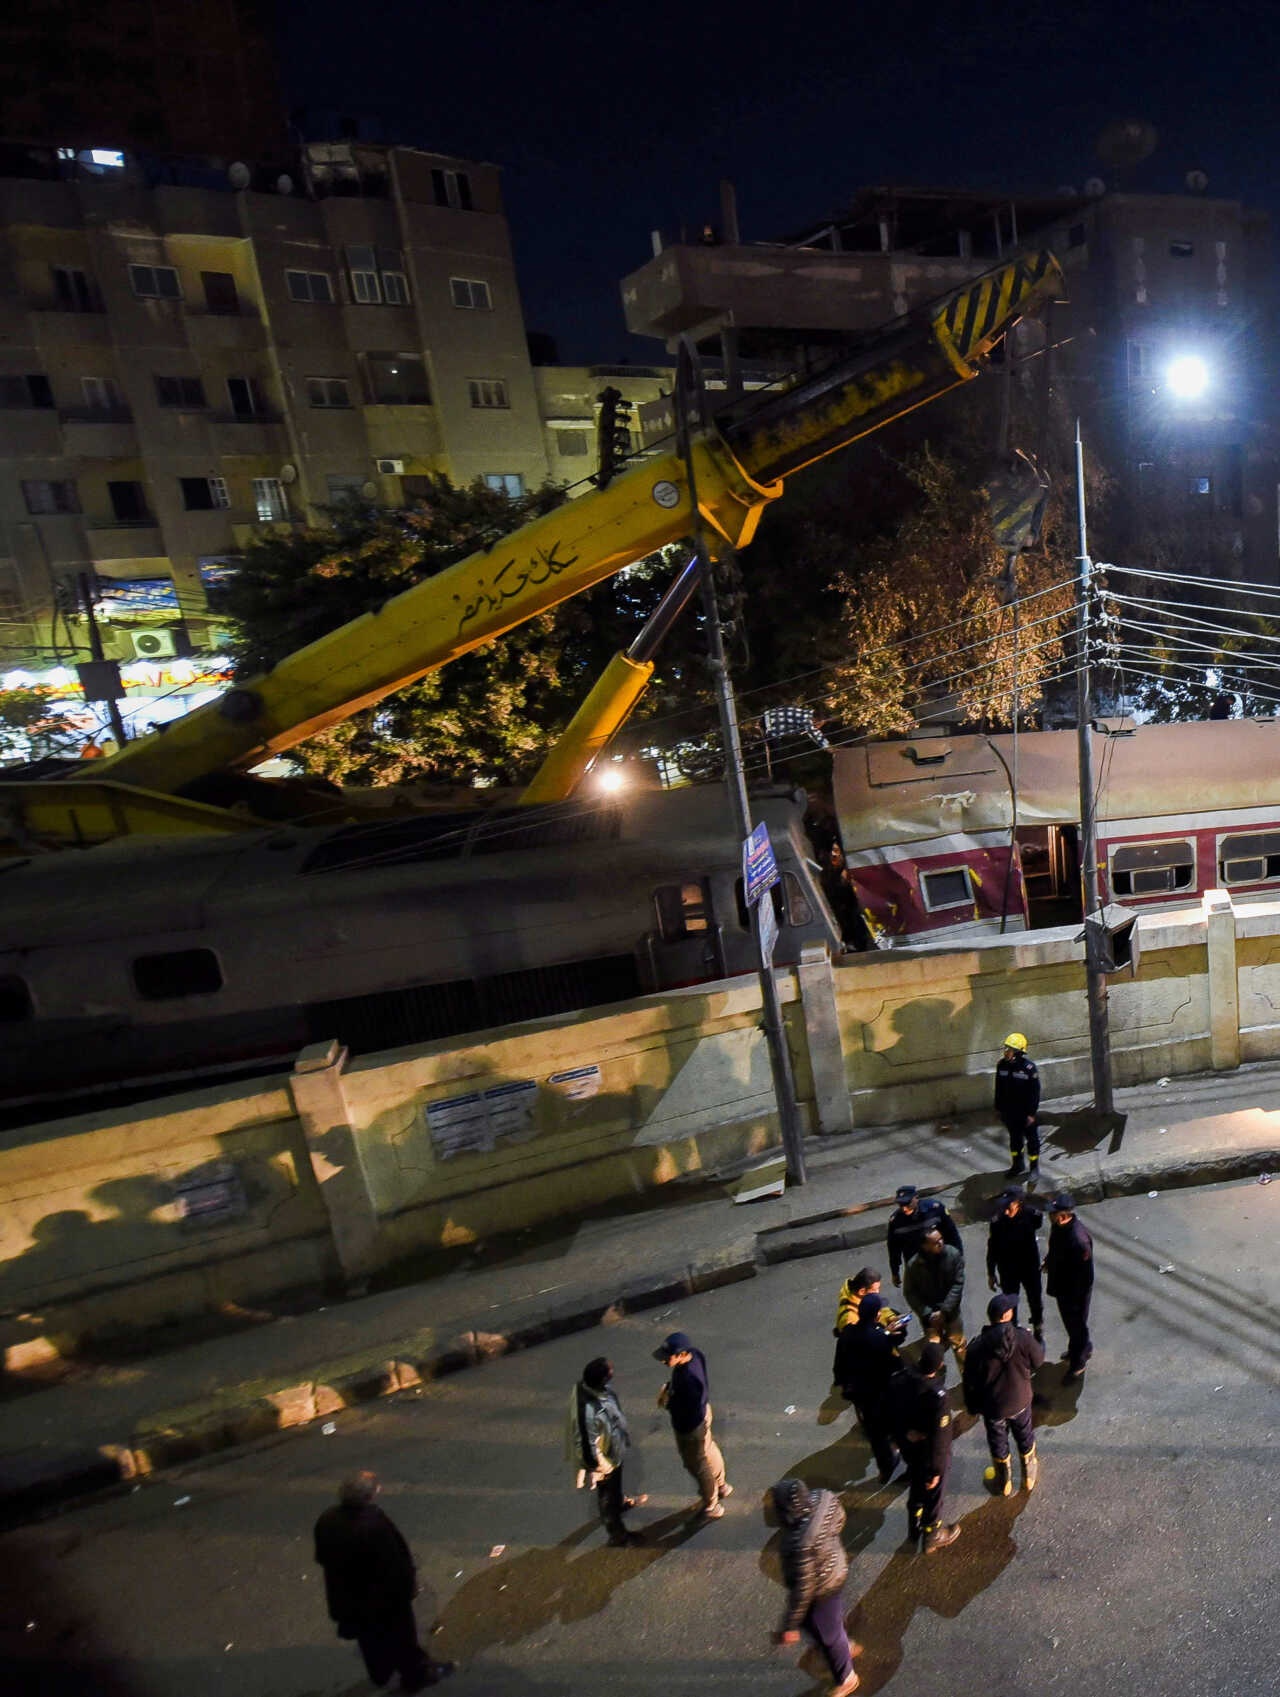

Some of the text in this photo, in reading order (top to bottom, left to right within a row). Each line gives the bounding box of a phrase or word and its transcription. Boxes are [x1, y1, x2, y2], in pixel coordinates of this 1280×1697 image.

[456, 541, 579, 634] سكك حديد مصر
